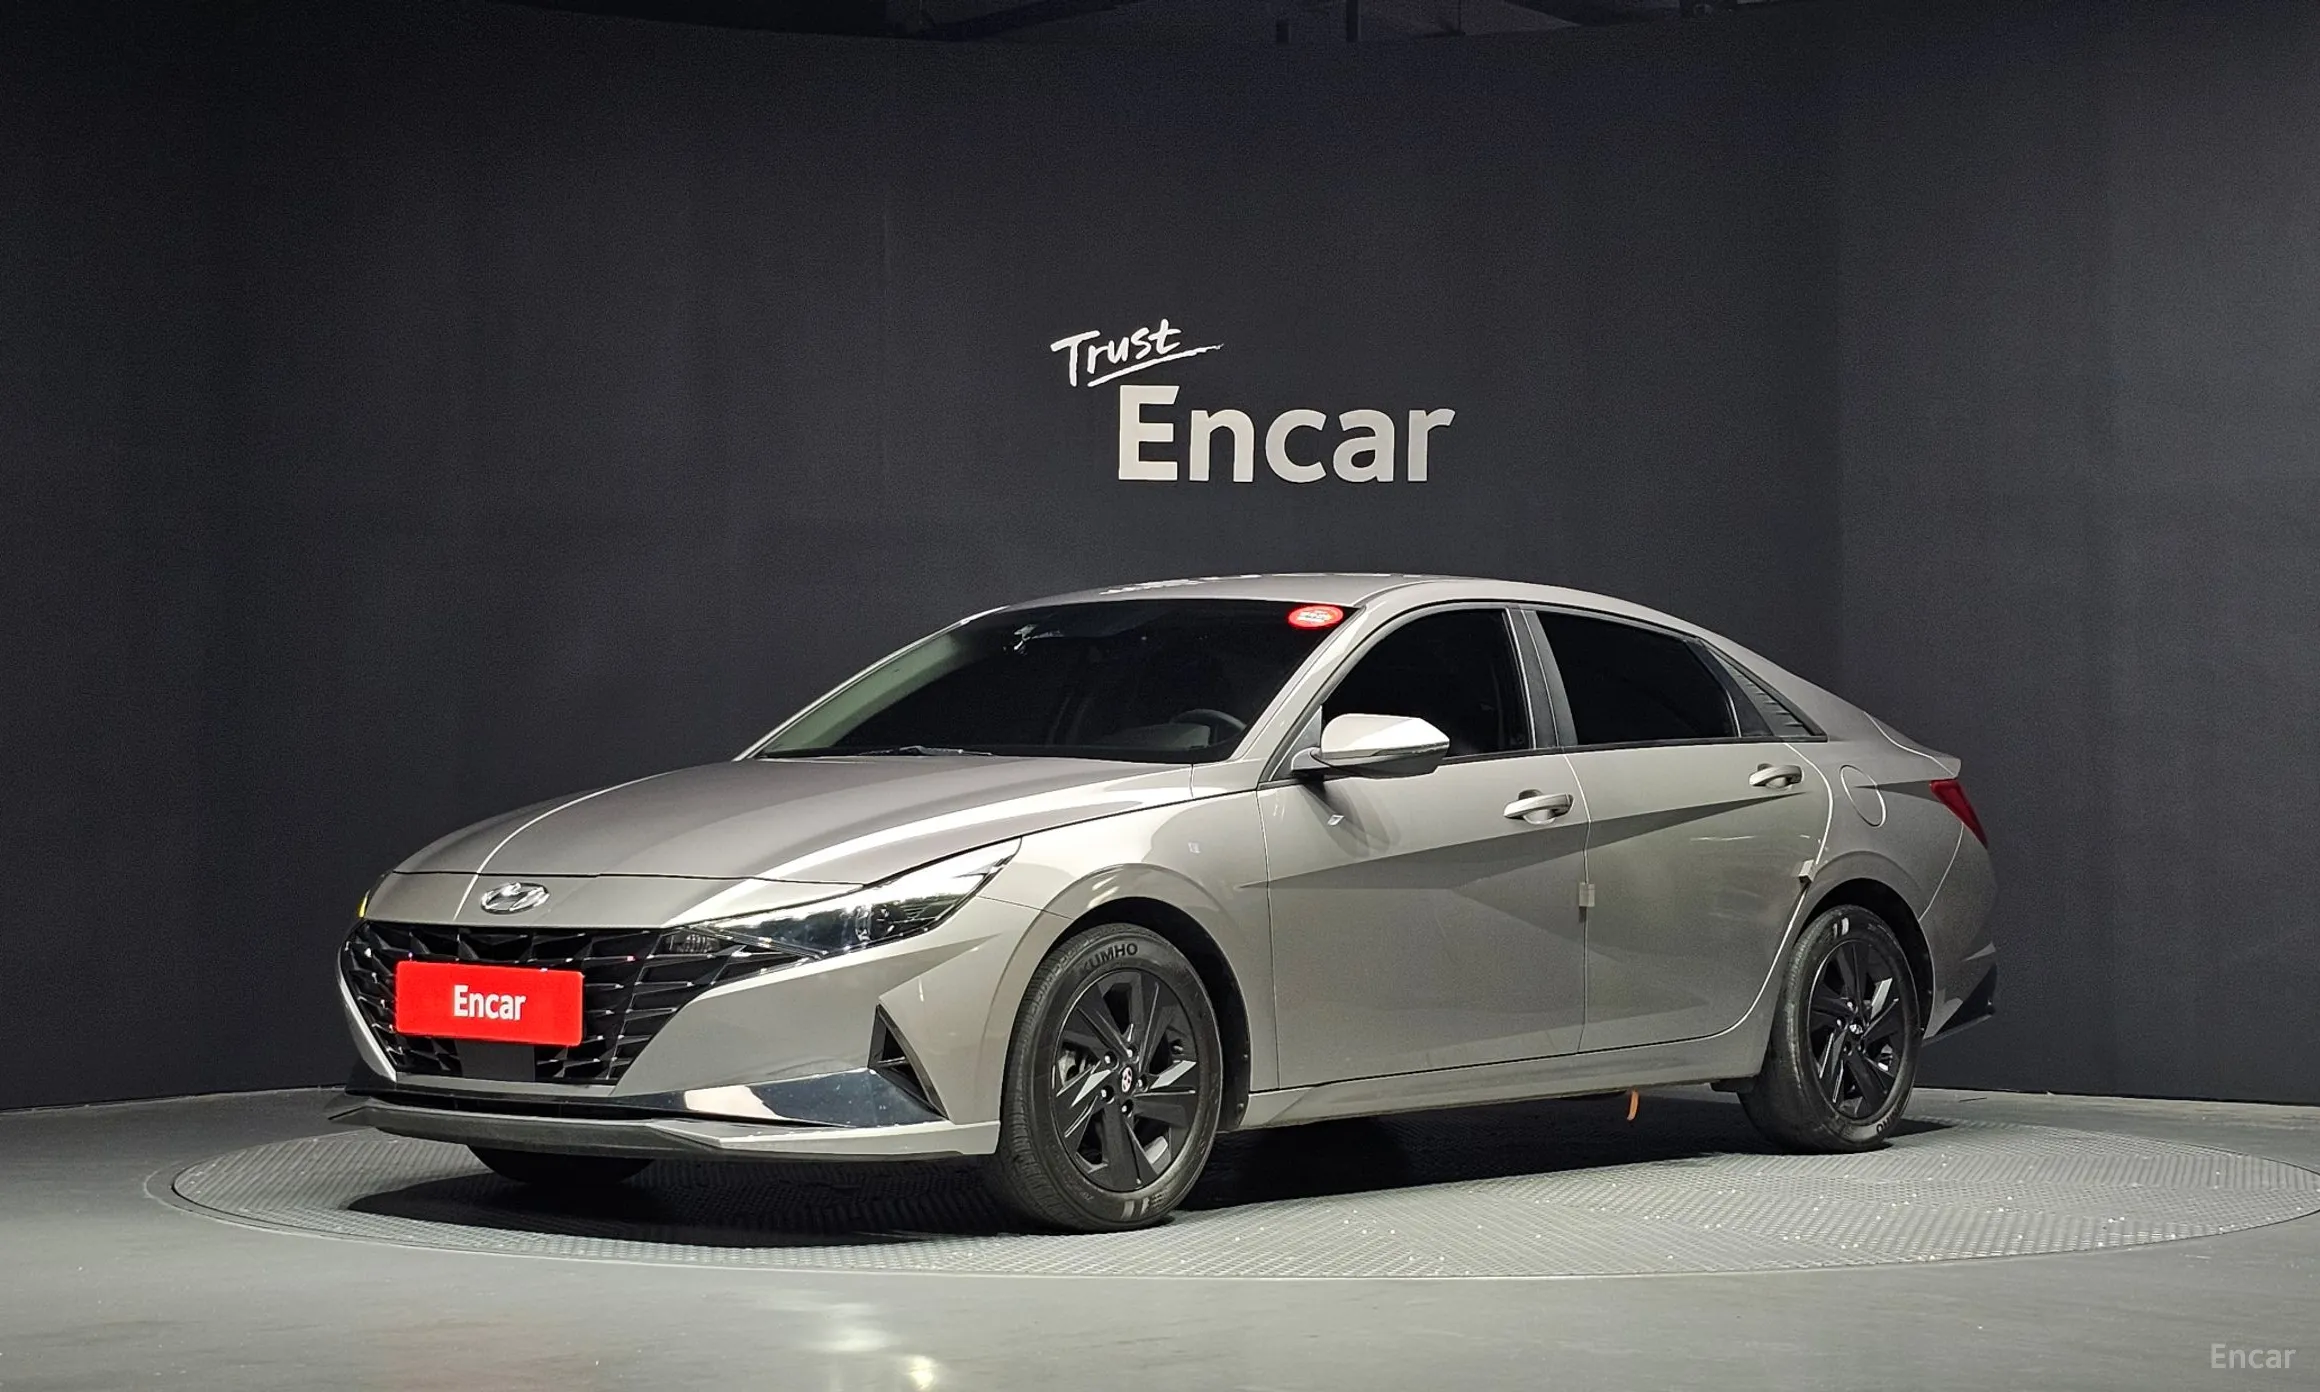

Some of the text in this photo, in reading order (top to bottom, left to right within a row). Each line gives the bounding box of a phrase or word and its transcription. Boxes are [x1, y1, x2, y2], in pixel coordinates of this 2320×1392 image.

[1050, 319, 1182, 387] Trust
[1118, 384, 1456, 484] Encar
[452, 985, 526, 1021] Encar
